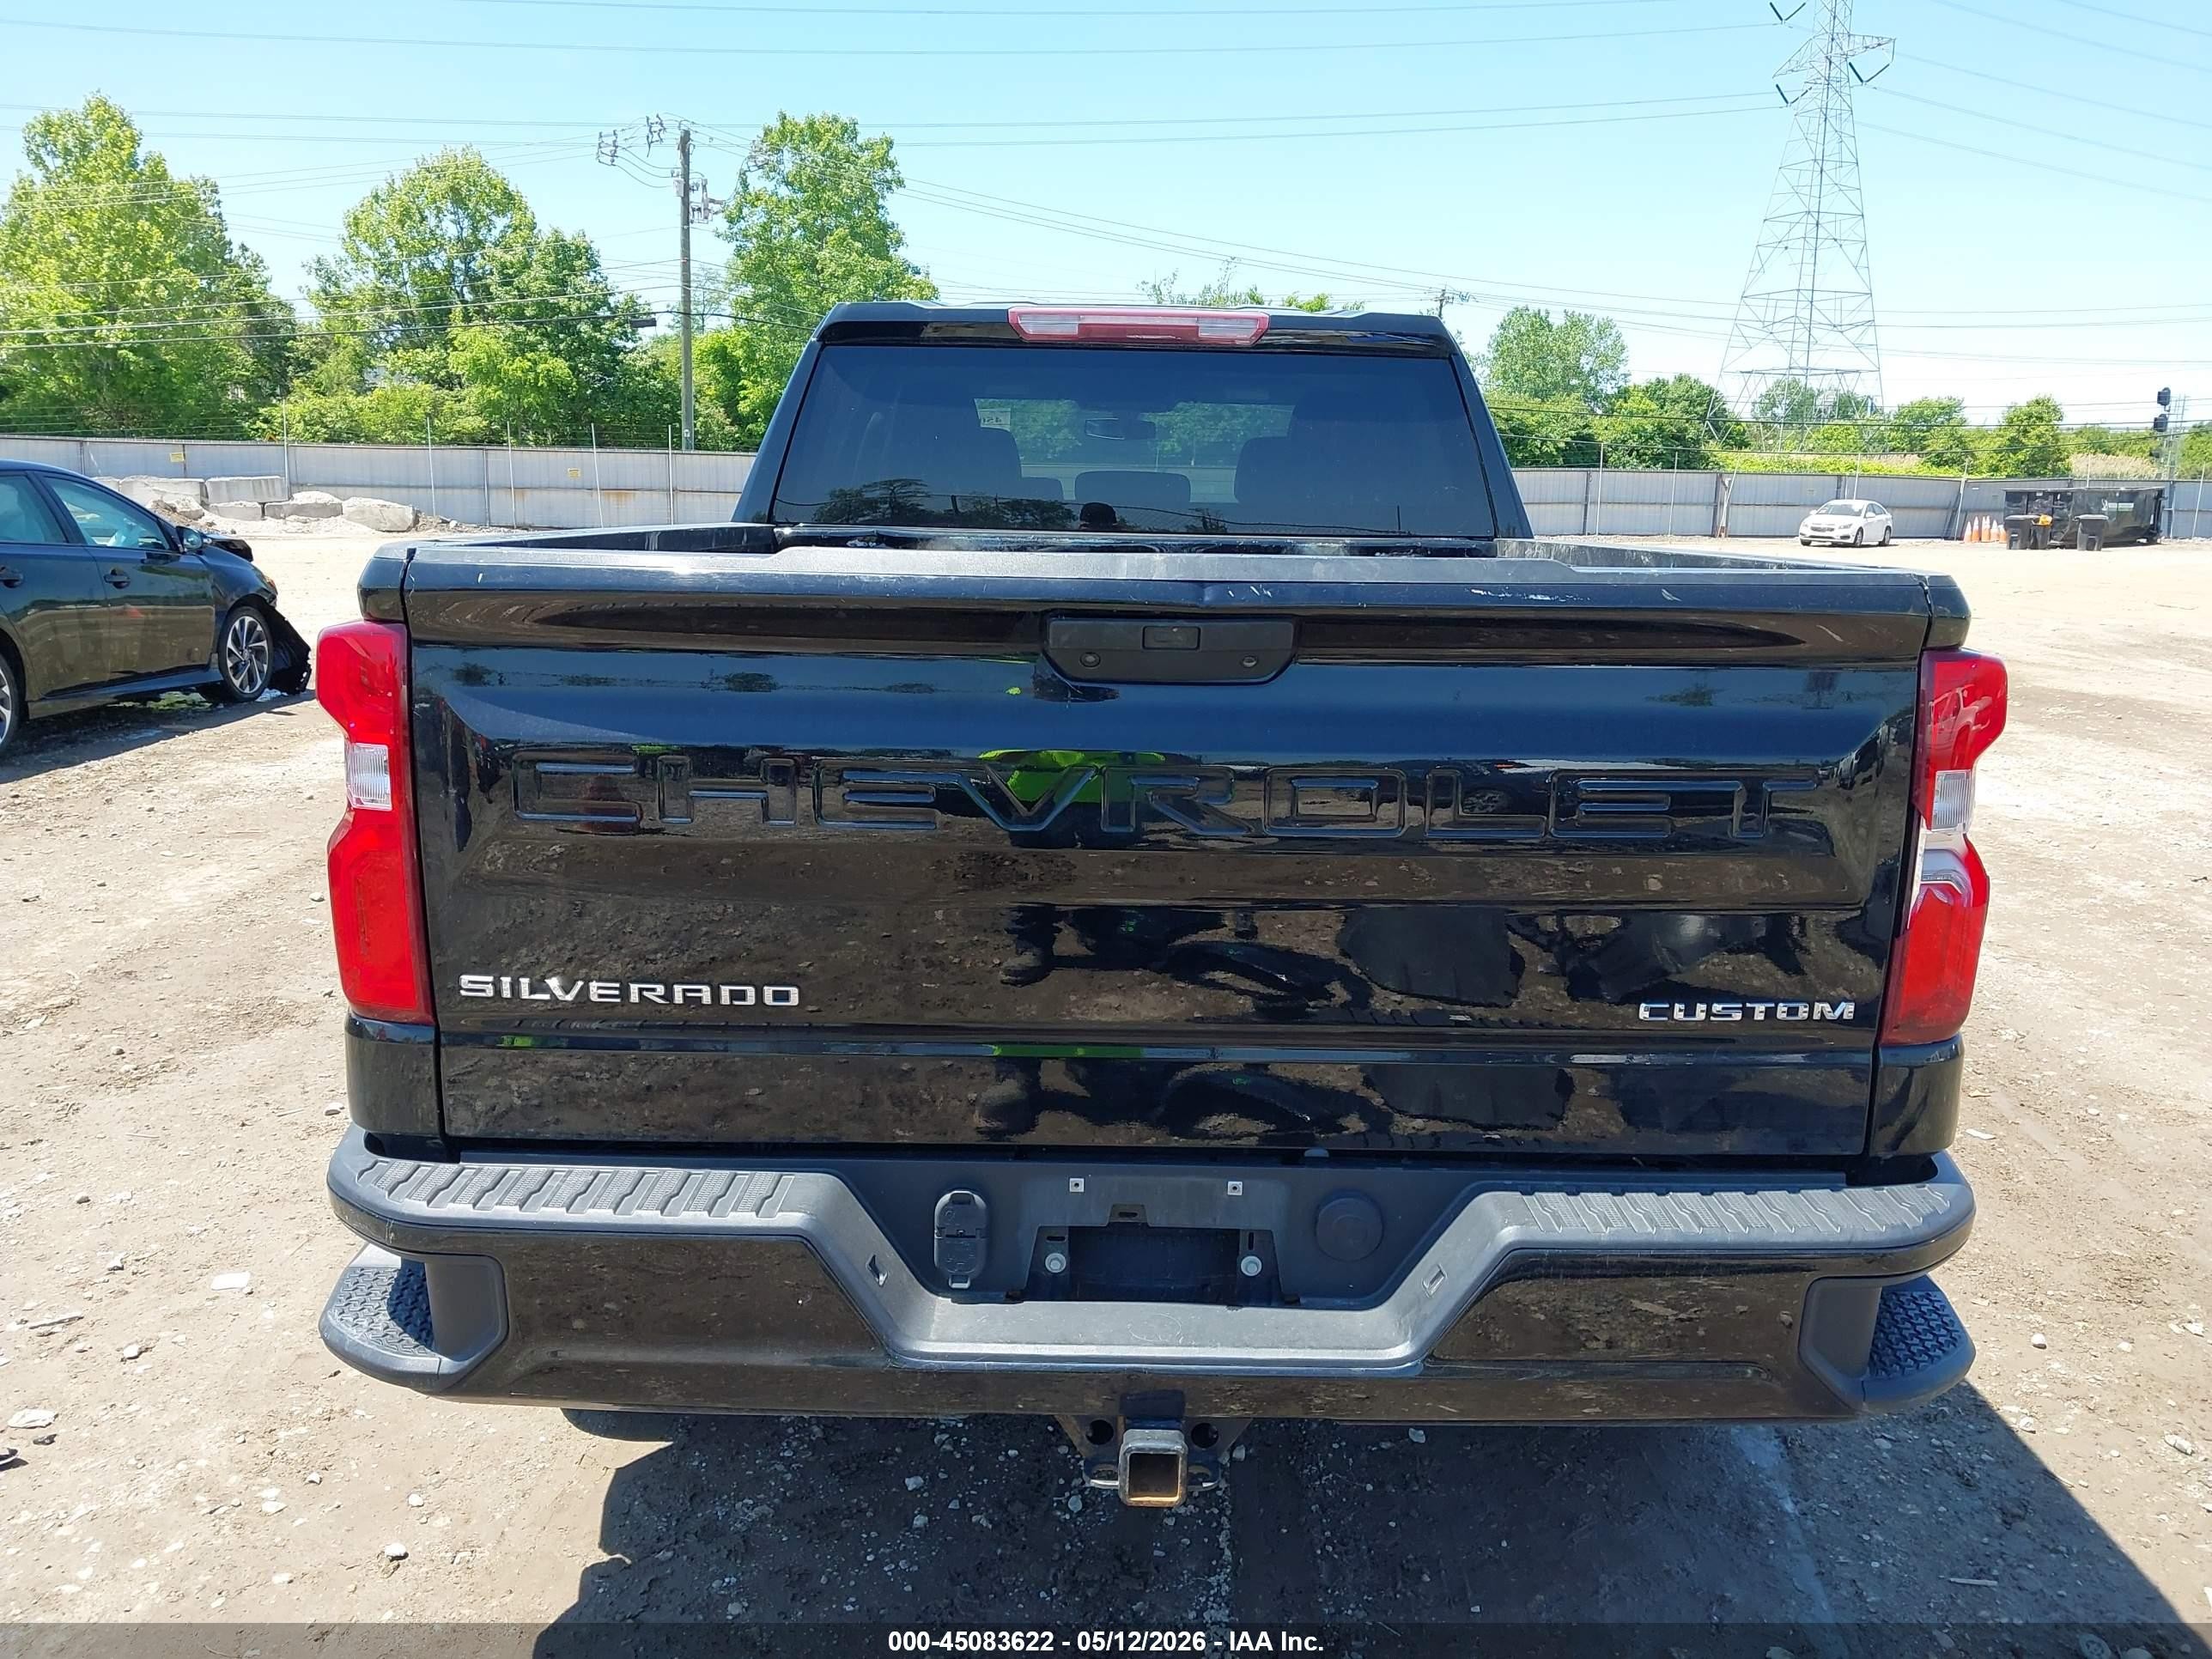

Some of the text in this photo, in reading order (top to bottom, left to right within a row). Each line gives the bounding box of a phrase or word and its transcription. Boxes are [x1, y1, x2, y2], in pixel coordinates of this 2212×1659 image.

[513, 750, 1817, 839] CHEVROLET
[459, 974, 800, 1006] SILVERADO
[1638, 1000, 1856, 1022] CUSTOM
